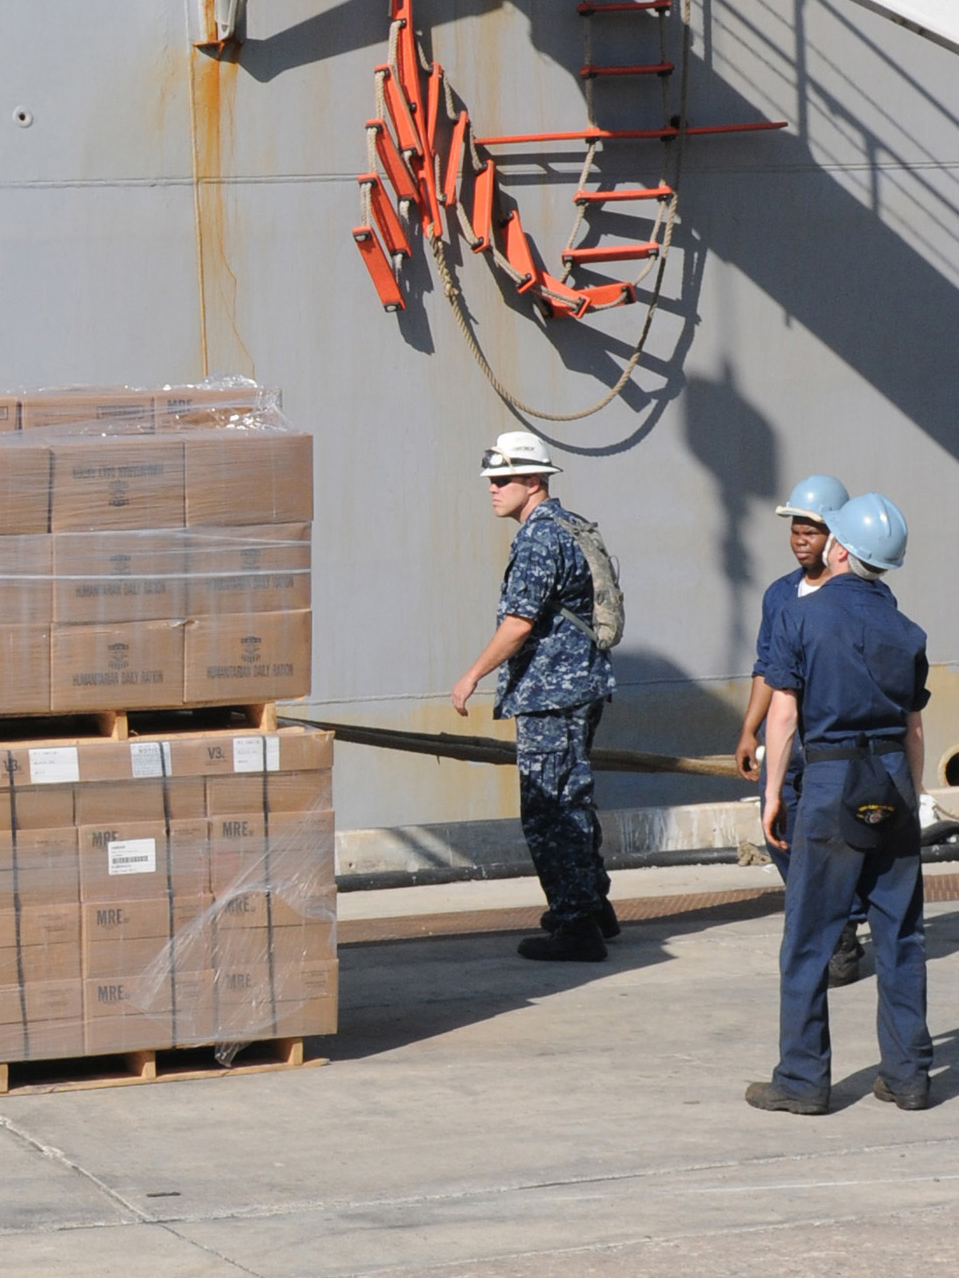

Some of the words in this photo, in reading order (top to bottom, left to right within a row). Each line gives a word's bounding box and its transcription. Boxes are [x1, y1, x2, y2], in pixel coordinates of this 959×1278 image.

[72, 672, 119, 686] HUMANITARIAN
[121, 671, 138, 685] DAILY
[142, 670, 163, 683] RATION
[207, 665, 251, 679] HUMANITARIAN
[253, 664, 270, 677] DAILY
[273, 663, 294, 677] RATION
[223, 821, 248, 837] MRE
[96, 908, 122, 925] MRE
[227, 973, 251, 989] MRE
[97, 985, 124, 1001] MRE
